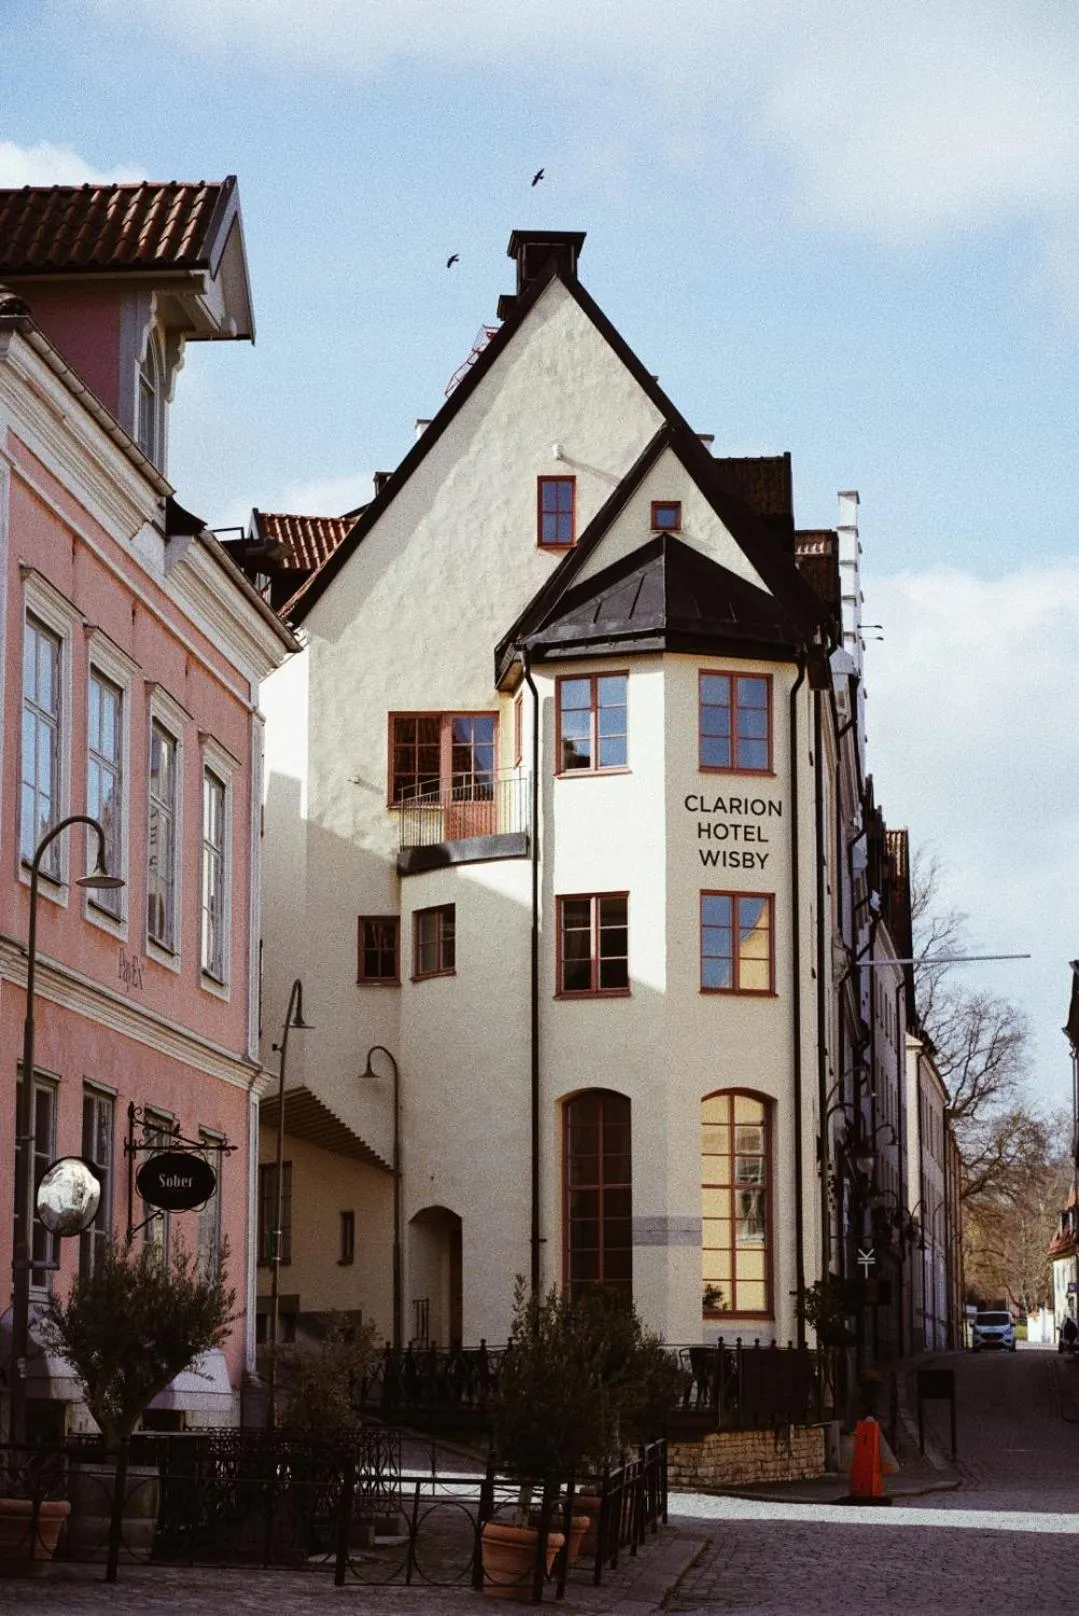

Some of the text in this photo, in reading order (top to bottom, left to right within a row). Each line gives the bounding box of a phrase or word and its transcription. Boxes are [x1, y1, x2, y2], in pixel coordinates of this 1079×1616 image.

[684, 794, 782, 817] CLARION
[698, 822, 769, 842] HOTEL
[699, 849, 769, 869] WISBY
[159, 1173, 193, 1188] Sober
